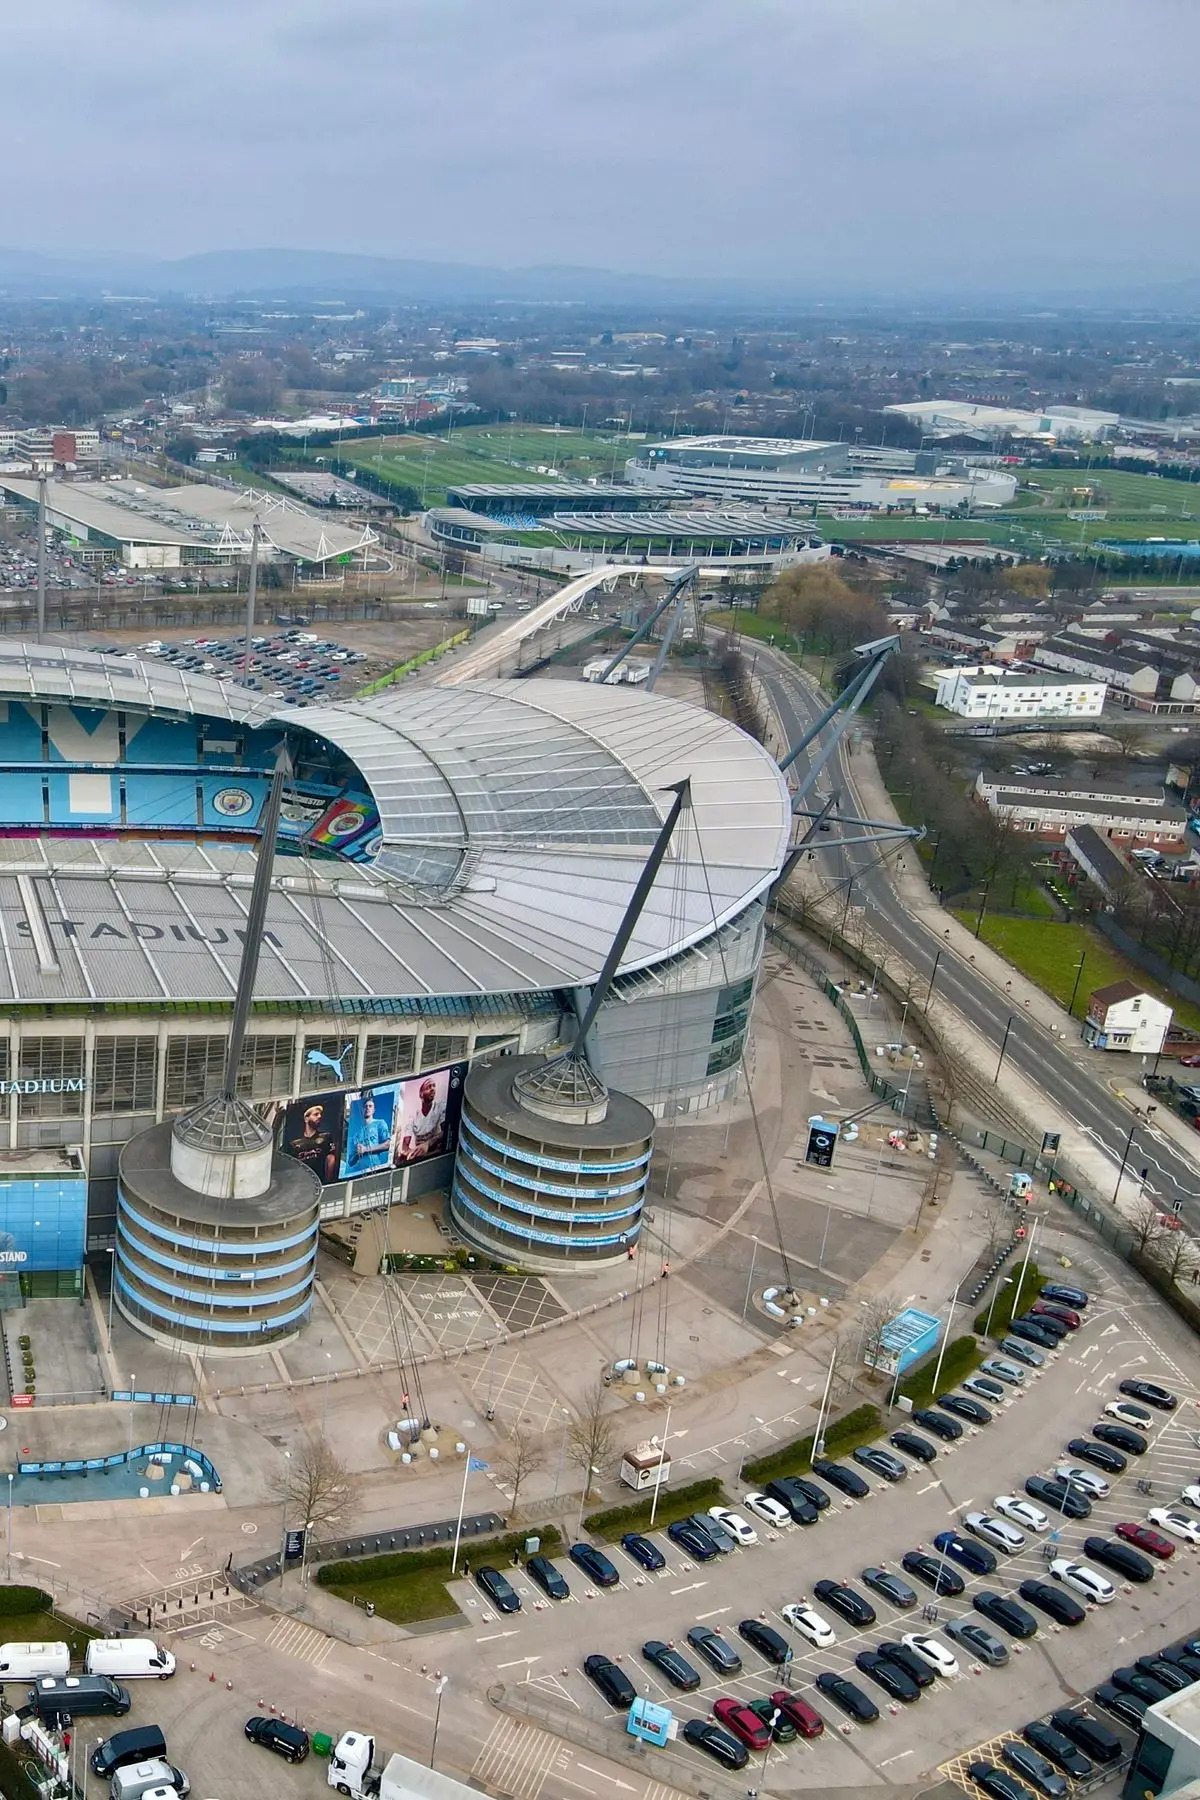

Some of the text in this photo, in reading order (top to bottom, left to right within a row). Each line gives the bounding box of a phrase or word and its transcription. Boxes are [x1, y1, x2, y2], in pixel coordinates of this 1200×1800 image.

[0, 1250, 27, 1264] STAND
[1086, 1386, 1109, 1398] EXIT
[175, 1563, 203, 1579] STOP
[200, 1628, 225, 1650] STOP
